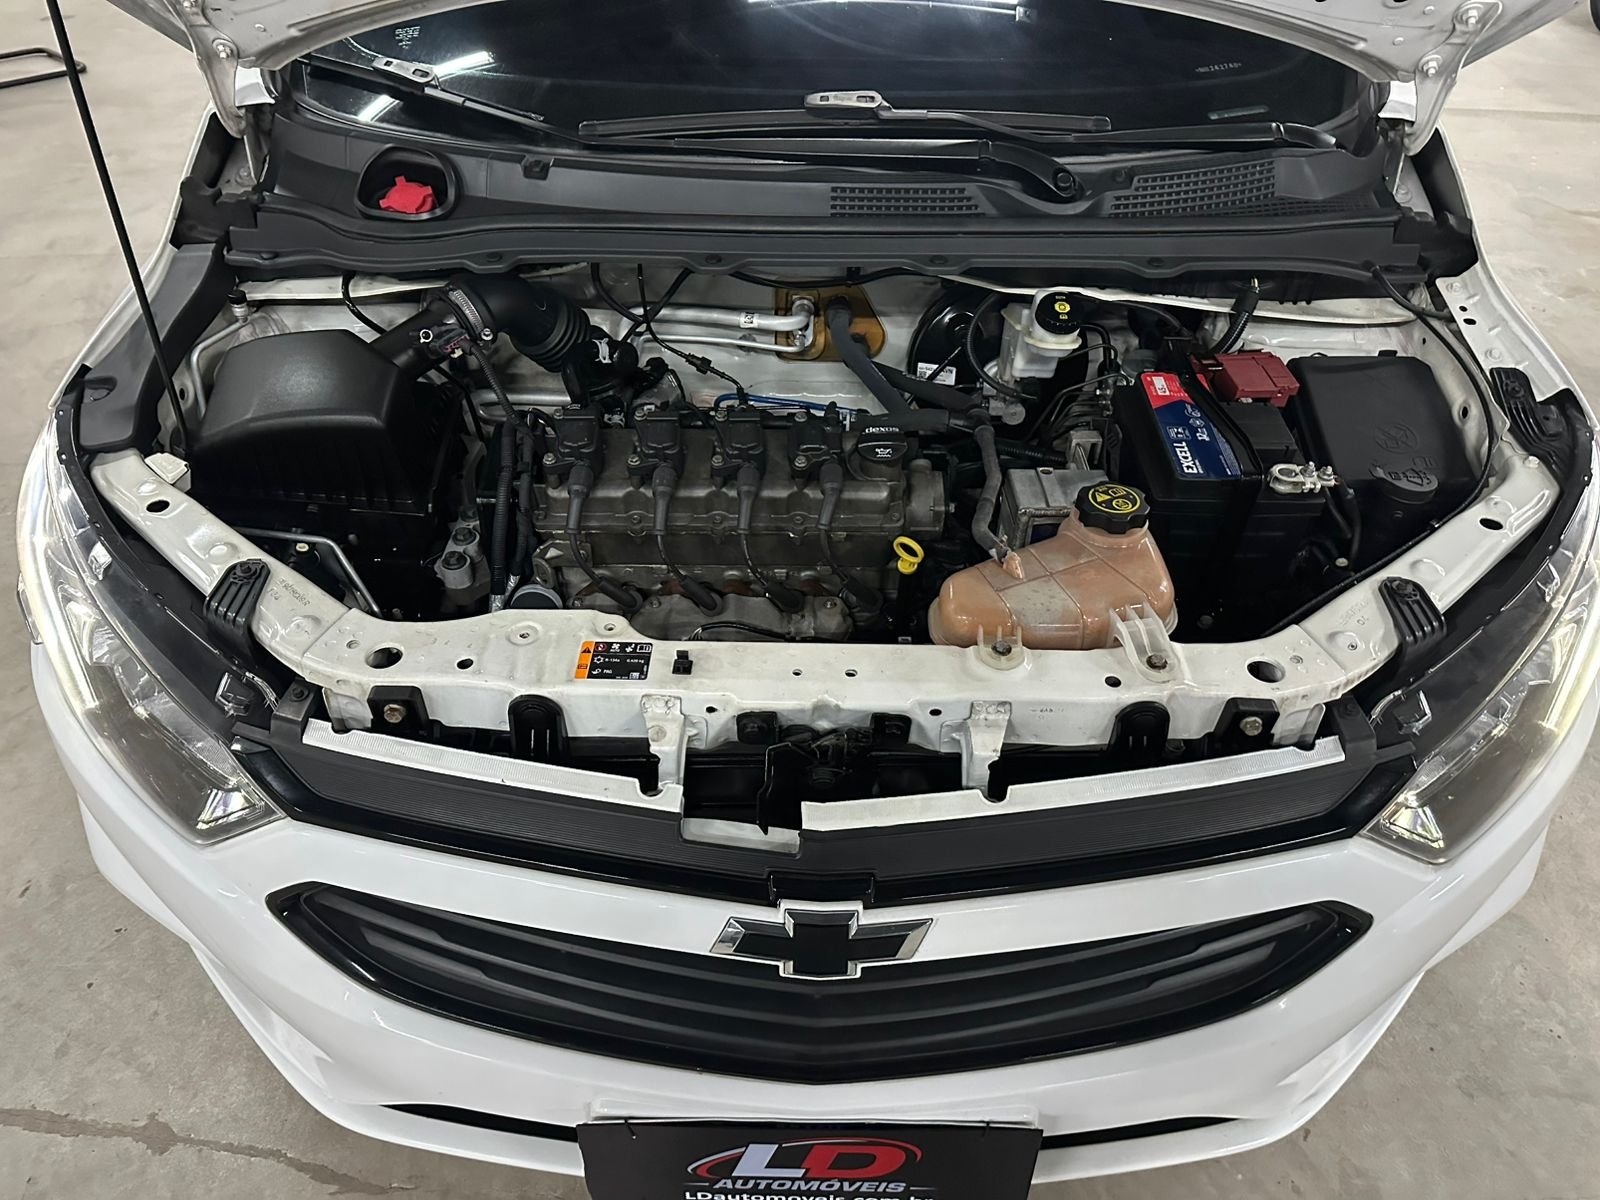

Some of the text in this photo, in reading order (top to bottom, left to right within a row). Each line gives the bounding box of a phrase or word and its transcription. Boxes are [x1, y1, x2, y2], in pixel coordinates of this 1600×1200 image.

[1173, 441, 1198, 473] EXCELL
[731, 1143, 906, 1178] LD
[713, 1179, 907, 1193] AUTOMÓVEIS
